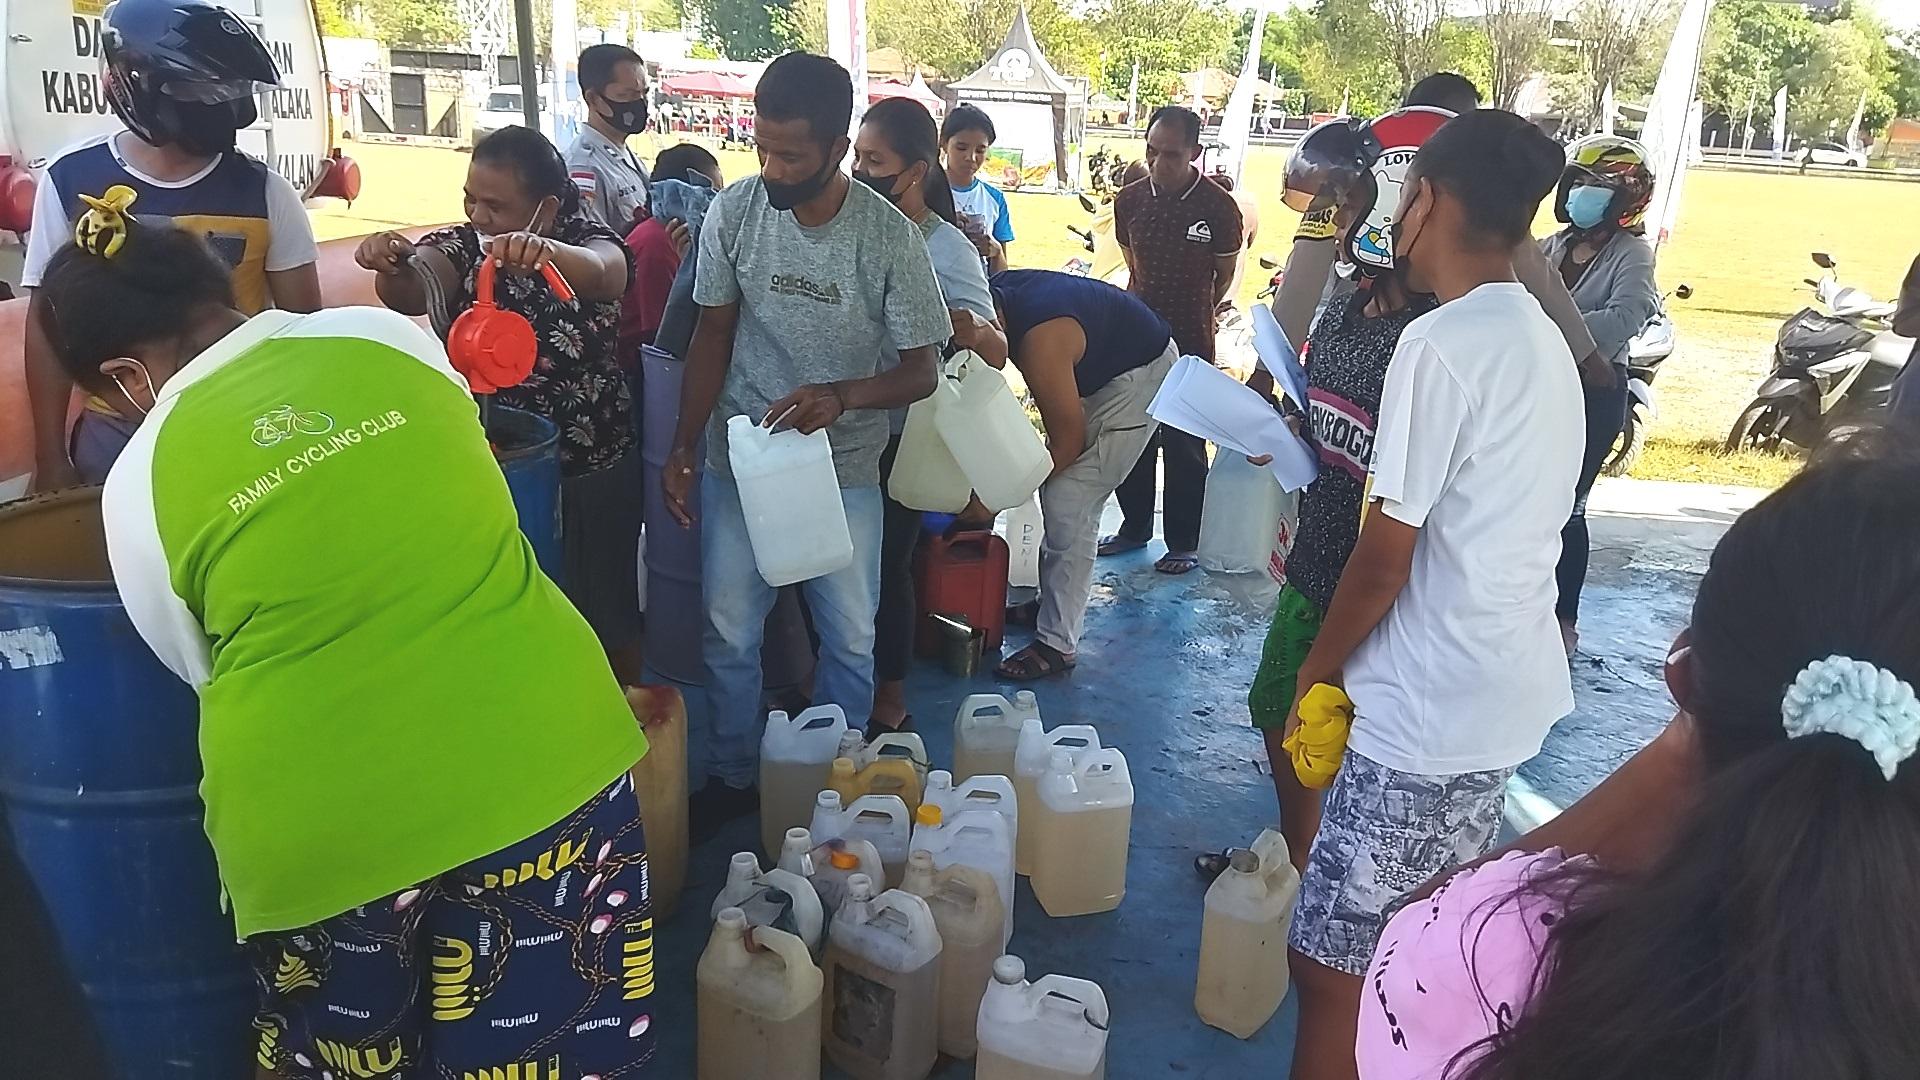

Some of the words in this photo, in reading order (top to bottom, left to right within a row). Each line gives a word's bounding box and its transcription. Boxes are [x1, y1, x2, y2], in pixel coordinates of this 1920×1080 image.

[1384, 153, 1415, 166] LOV
[227, 467, 284, 515] FAMILY
[286, 428, 362, 474] CYCLING
[361, 410, 408, 436] CLUB
